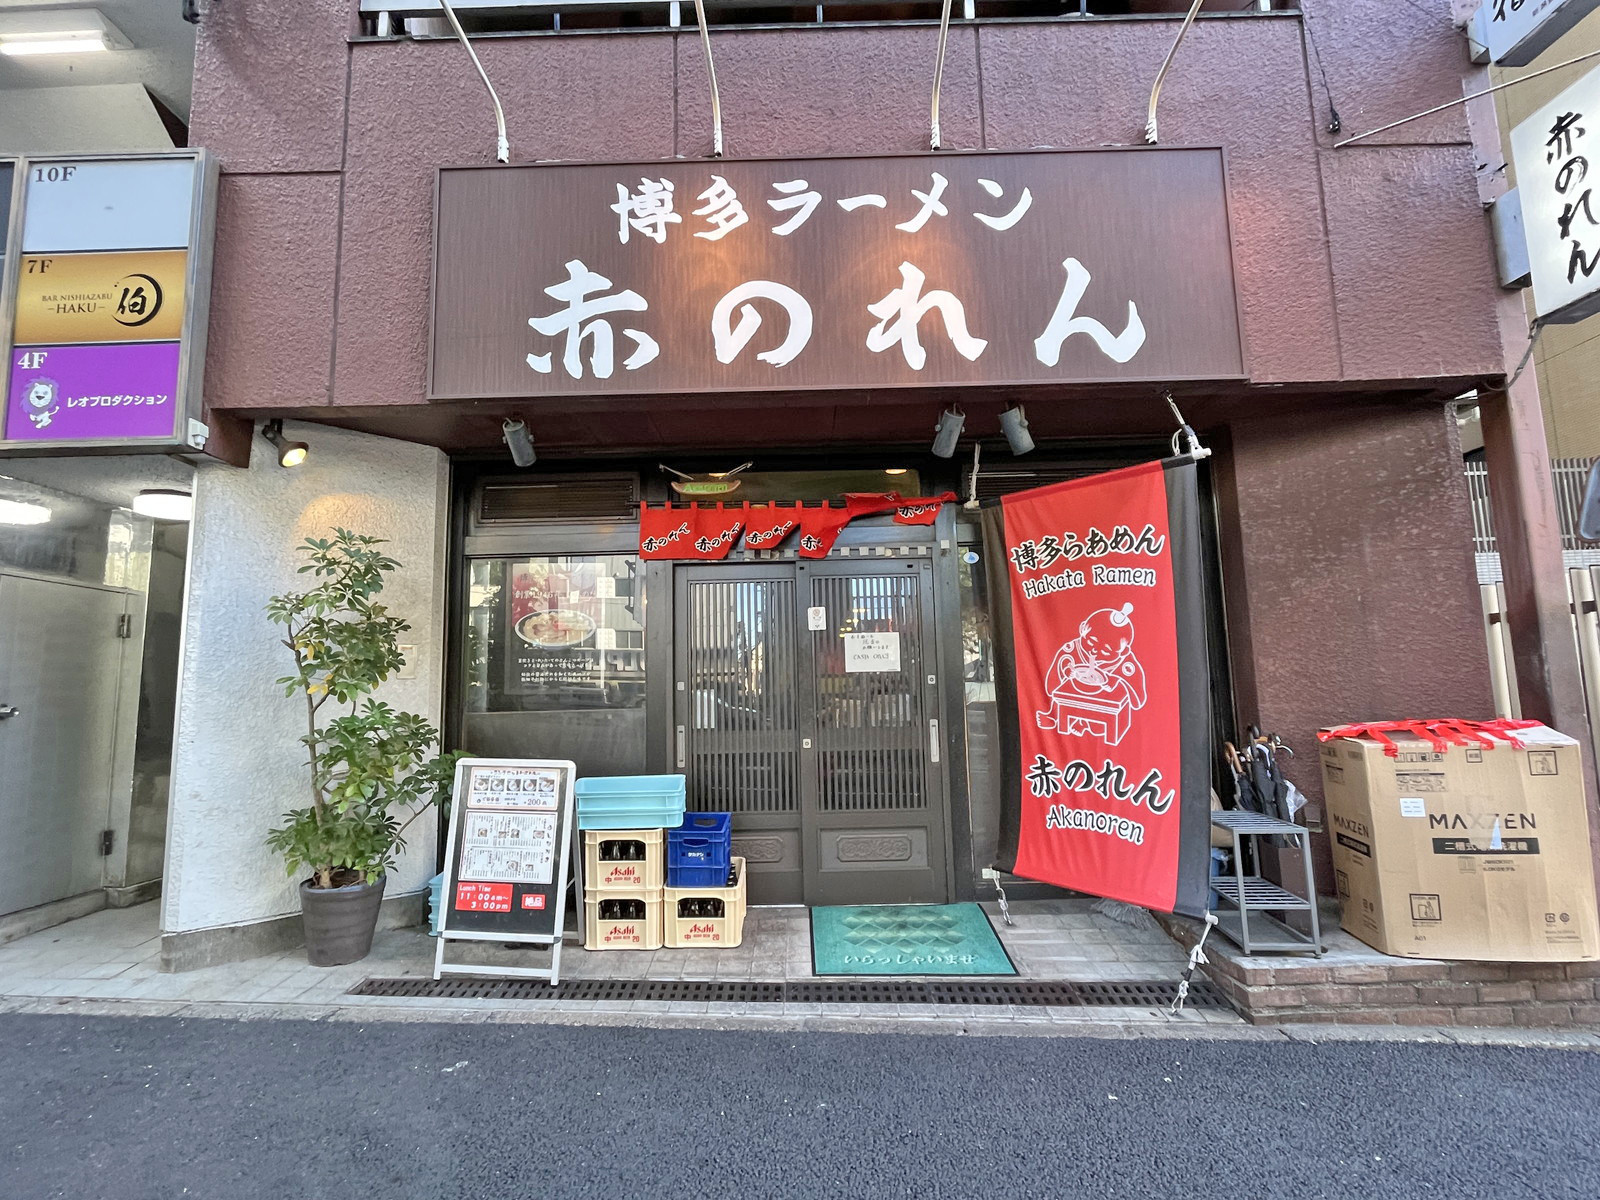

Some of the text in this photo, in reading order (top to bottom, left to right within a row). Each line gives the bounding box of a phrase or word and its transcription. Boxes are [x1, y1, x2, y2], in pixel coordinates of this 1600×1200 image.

[35, 166, 77, 183] 10F
[610, 172, 1033, 244] 博多ラーメン
[1545, 111, 1600, 284] 赤のれん
[27, 259, 53, 274] 7F
[41, 292, 113, 302] BAR NISHIAZABU
[116, 286, 147, 315] 伯
[526, 256, 1148, 380] 赤のれん
[17, 351, 48, 369] 4F
[66, 393, 168, 409] レオプロダクション
[642, 522, 690, 552] 赤のれん
[1009, 523, 1166, 573] 博多らあめん
[1023, 563, 1158, 599] Hakata Ramen
[1025, 753, 1176, 815] 赤のれん
[1045, 803, 1145, 846] Akanoren
[1333, 813, 1370, 838] MAXZEN
[610, 866, 635, 876] Asahi
[459, 884, 476, 892] Lunch
[610, 925, 635, 935] Asahi
[690, 923, 714, 933] Asahi
[844, 954, 978, 966] いらっしゃいませ
